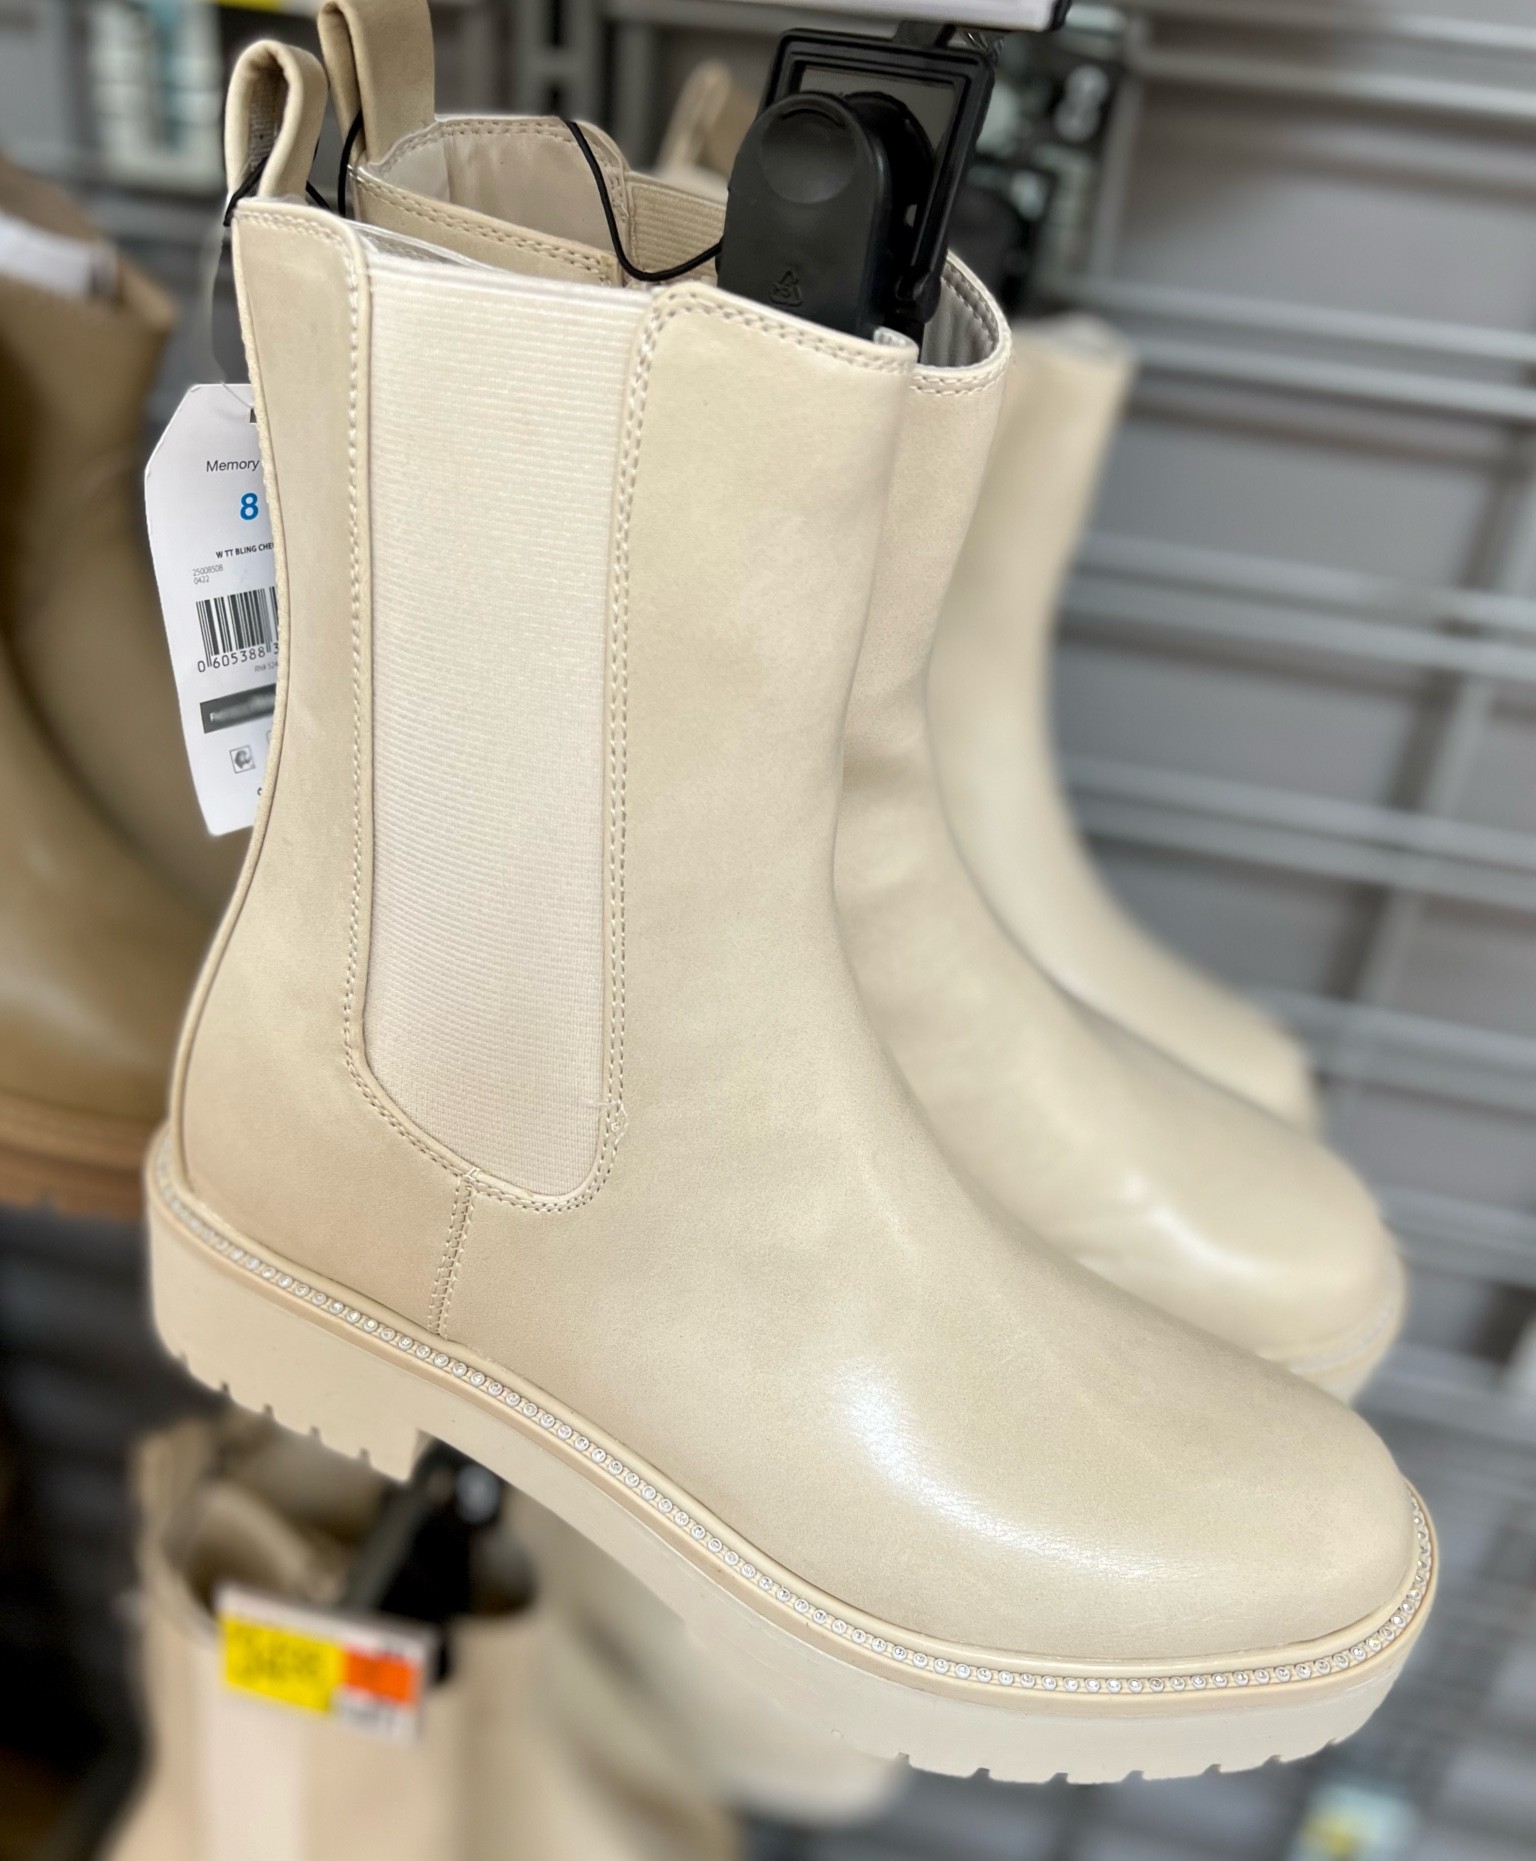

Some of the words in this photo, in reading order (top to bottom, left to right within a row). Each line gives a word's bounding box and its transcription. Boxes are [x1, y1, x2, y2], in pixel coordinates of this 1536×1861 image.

[206, 459, 260, 473] Memory
[240, 492, 259, 521] 8
[215, 550, 224, 559] W
[224, 548, 234, 558] TT
[235, 544, 257, 556] BLING
[258, 541, 275, 552] CHE
[212, 646, 266, 669] 605388
